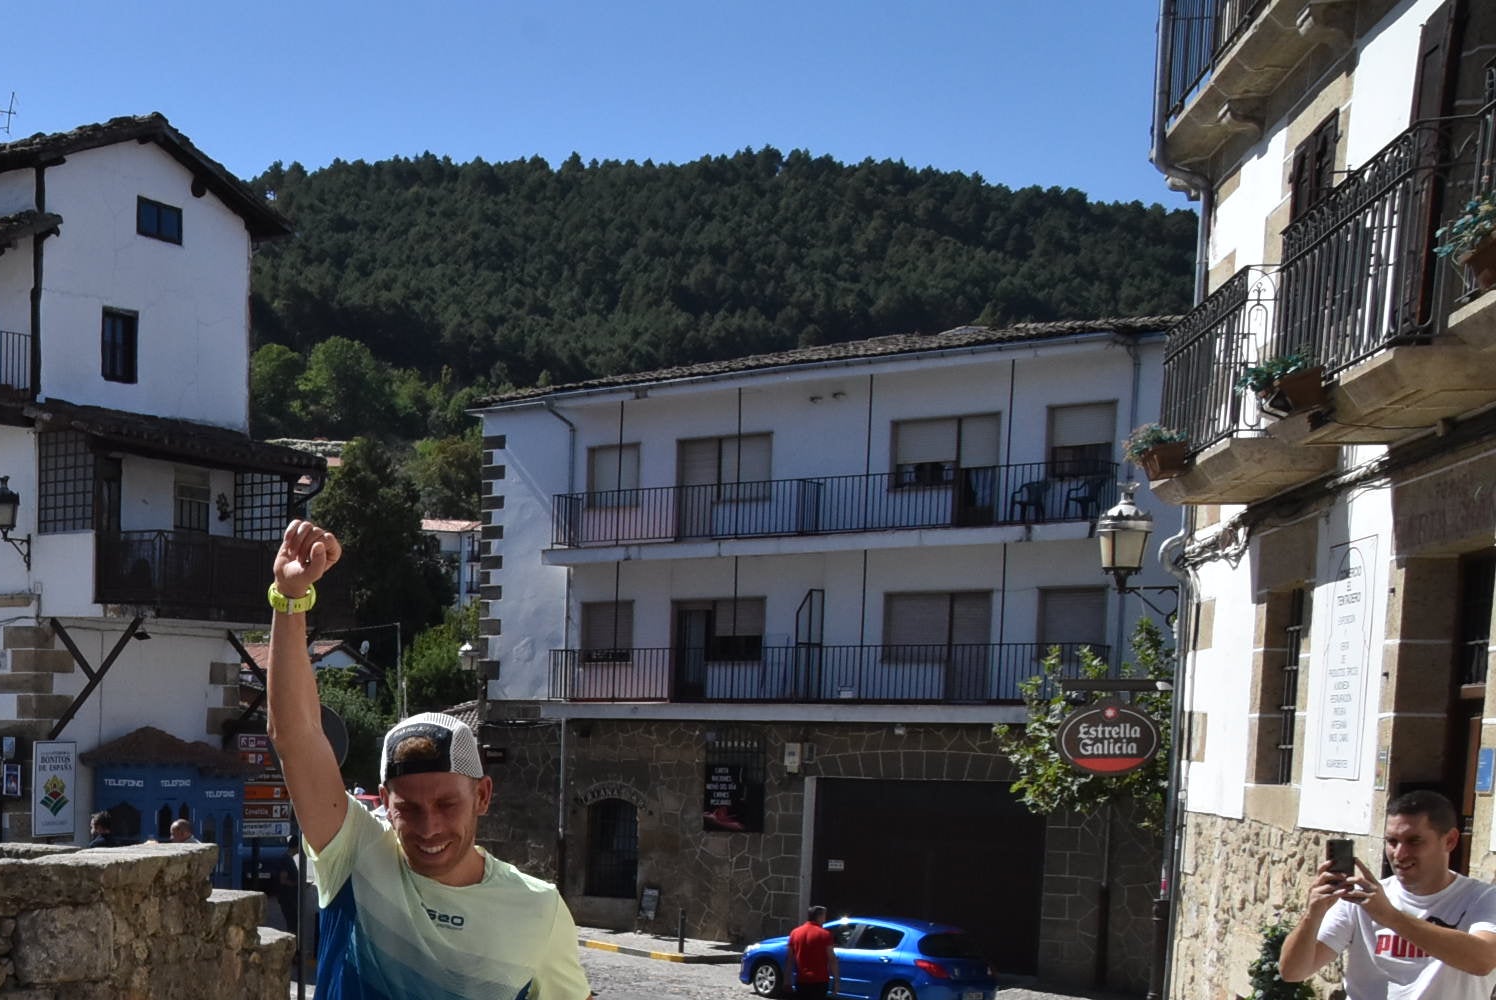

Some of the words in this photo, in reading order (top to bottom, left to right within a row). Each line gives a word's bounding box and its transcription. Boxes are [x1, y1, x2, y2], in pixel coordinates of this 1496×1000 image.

[1078, 723, 1141, 738] Estrella
[1079, 738, 1137, 755] Galicia
[40, 756, 71, 764] BONITOS
[104, 779, 144, 788] TELEFONO
[160, 779, 191, 787] TELEFONO
